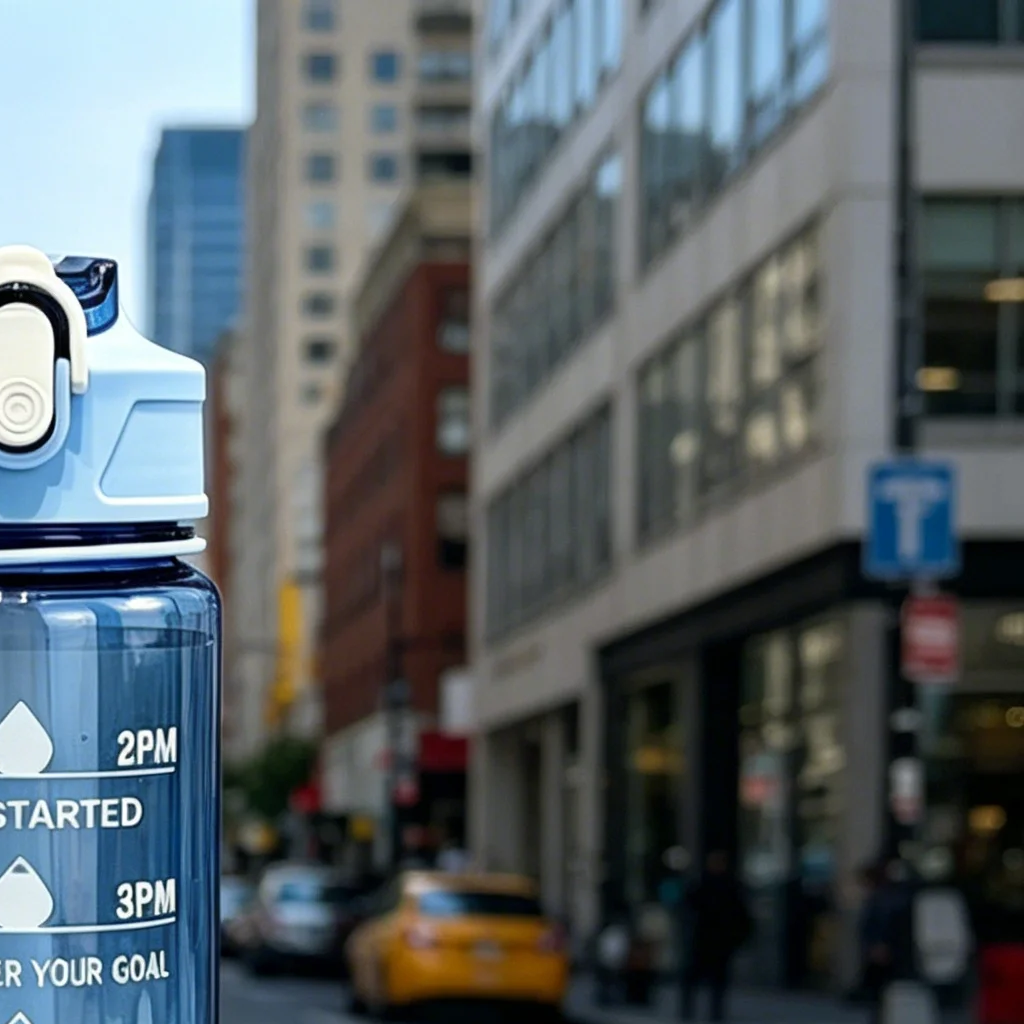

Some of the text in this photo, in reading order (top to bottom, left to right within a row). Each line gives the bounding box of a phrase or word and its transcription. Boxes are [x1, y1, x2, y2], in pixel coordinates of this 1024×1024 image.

[117, 727, 177, 766] 2PM
[116, 878, 176, 919] 3PM
[31, 957, 102, 988] YOUR
[112, 950, 169, 984] GOAL
